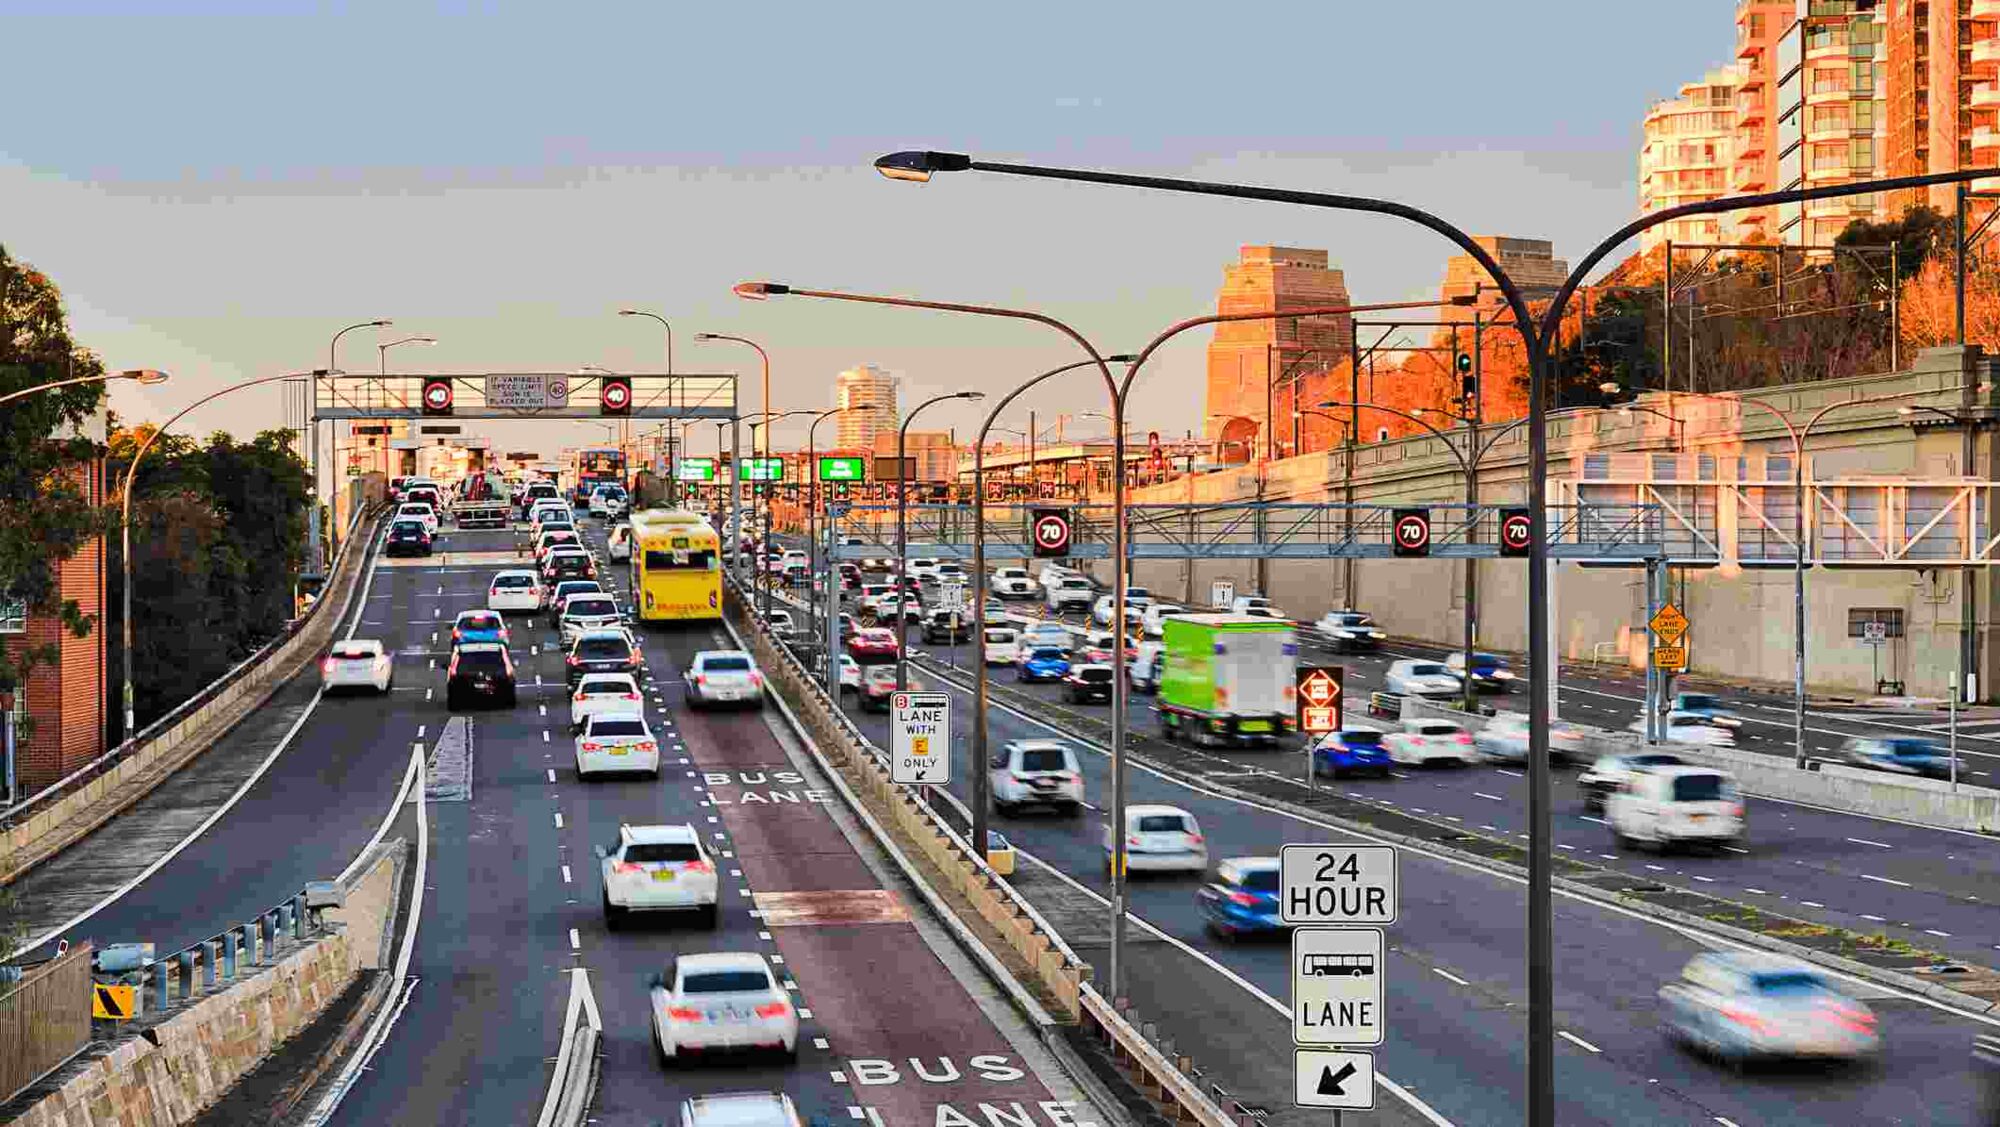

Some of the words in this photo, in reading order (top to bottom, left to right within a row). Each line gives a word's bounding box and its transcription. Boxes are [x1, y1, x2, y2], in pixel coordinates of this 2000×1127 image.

[429, 389, 446, 402] 40
[607, 389, 624, 402] 40
[1041, 524, 1060, 540] 70
[1402, 525, 1420, 539] 70
[1509, 525, 1527, 539] 70
[900, 711, 942, 721] LANE
[906, 725, 936, 734] WITH
[915, 740, 925, 753] E
[904, 758, 937, 767] ONLY
[703, 772, 804, 785] BUS
[707, 790, 833, 804] LANE
[1315, 853, 1360, 882] 24
[1290, 886, 1386, 916] HOUR
[1303, 1002, 1373, 1026] LANE
[850, 1055, 1025, 1085] BUS
